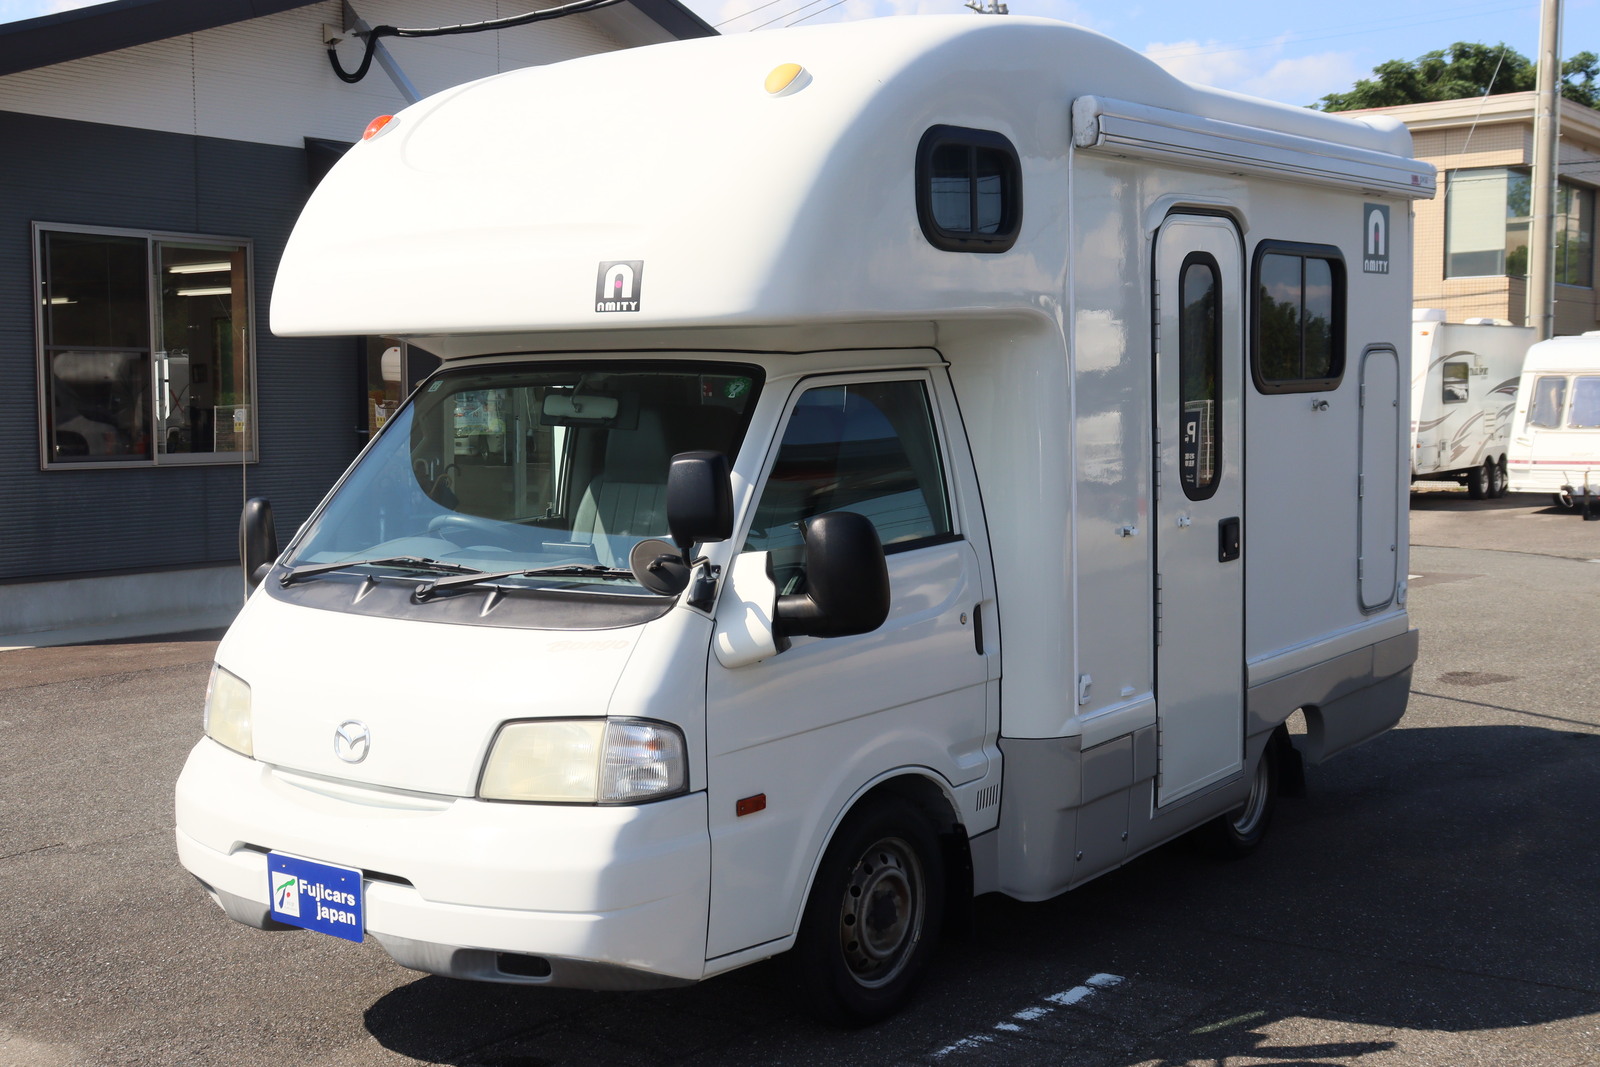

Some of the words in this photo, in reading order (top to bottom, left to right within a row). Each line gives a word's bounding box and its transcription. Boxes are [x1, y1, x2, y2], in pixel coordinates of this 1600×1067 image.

[1364, 259, 1388, 272] AMITY
[596, 301, 638, 312] AMITY
[299, 878, 356, 906] Fujicars
